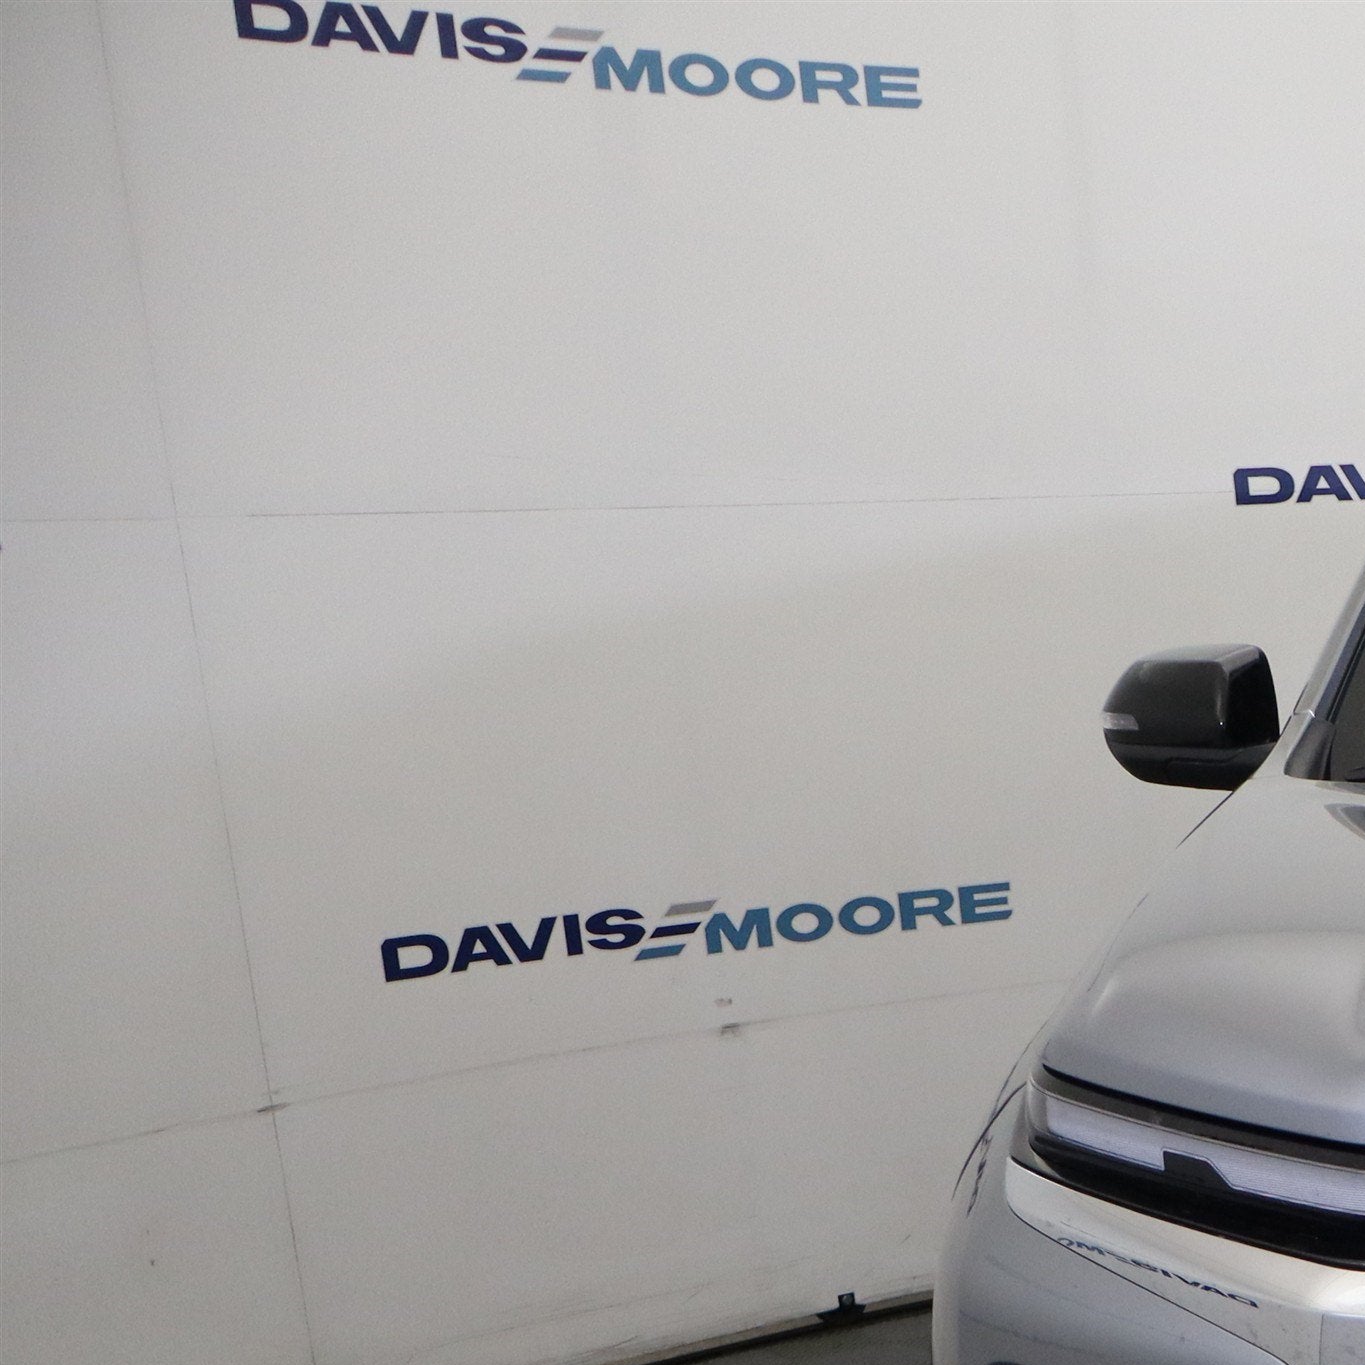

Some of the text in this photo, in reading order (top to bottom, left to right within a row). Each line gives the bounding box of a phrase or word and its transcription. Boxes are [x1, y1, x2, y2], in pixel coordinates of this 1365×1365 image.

[234, 0, 923, 109] DAVIS MOORE
[381, 882, 1013, 983] DAVIS MOORE
